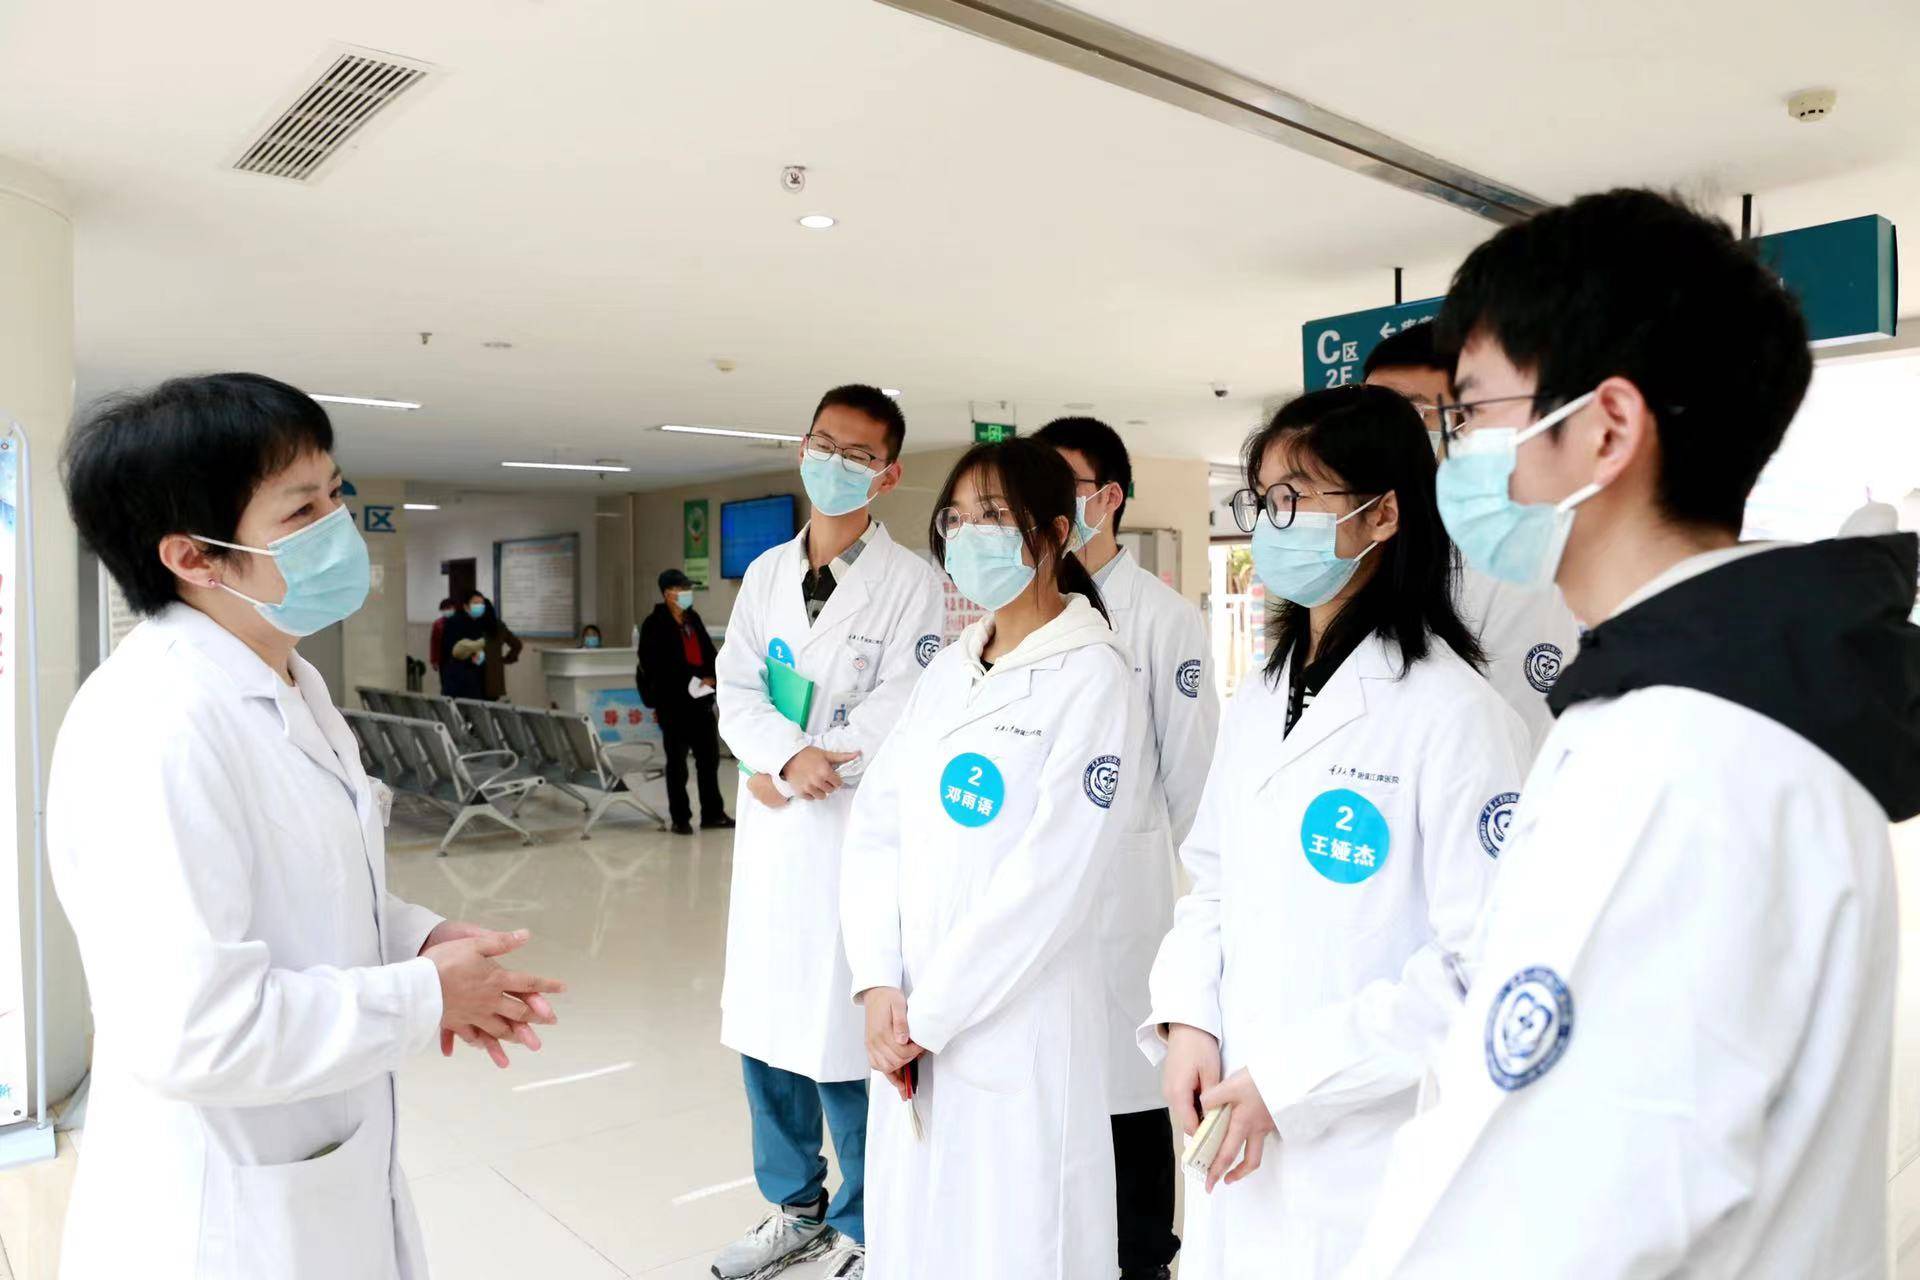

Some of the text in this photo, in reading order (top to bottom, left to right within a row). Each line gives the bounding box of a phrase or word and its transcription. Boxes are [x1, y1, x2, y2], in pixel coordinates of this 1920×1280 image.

[1316, 329, 1360, 365] C区
[775, 645, 784, 659] 2
[967, 765, 983, 787] 2
[944, 784, 994, 817] 邓雨语
[1335, 804, 1355, 832] 2
[1308, 833, 1376, 868] 王娅杰
